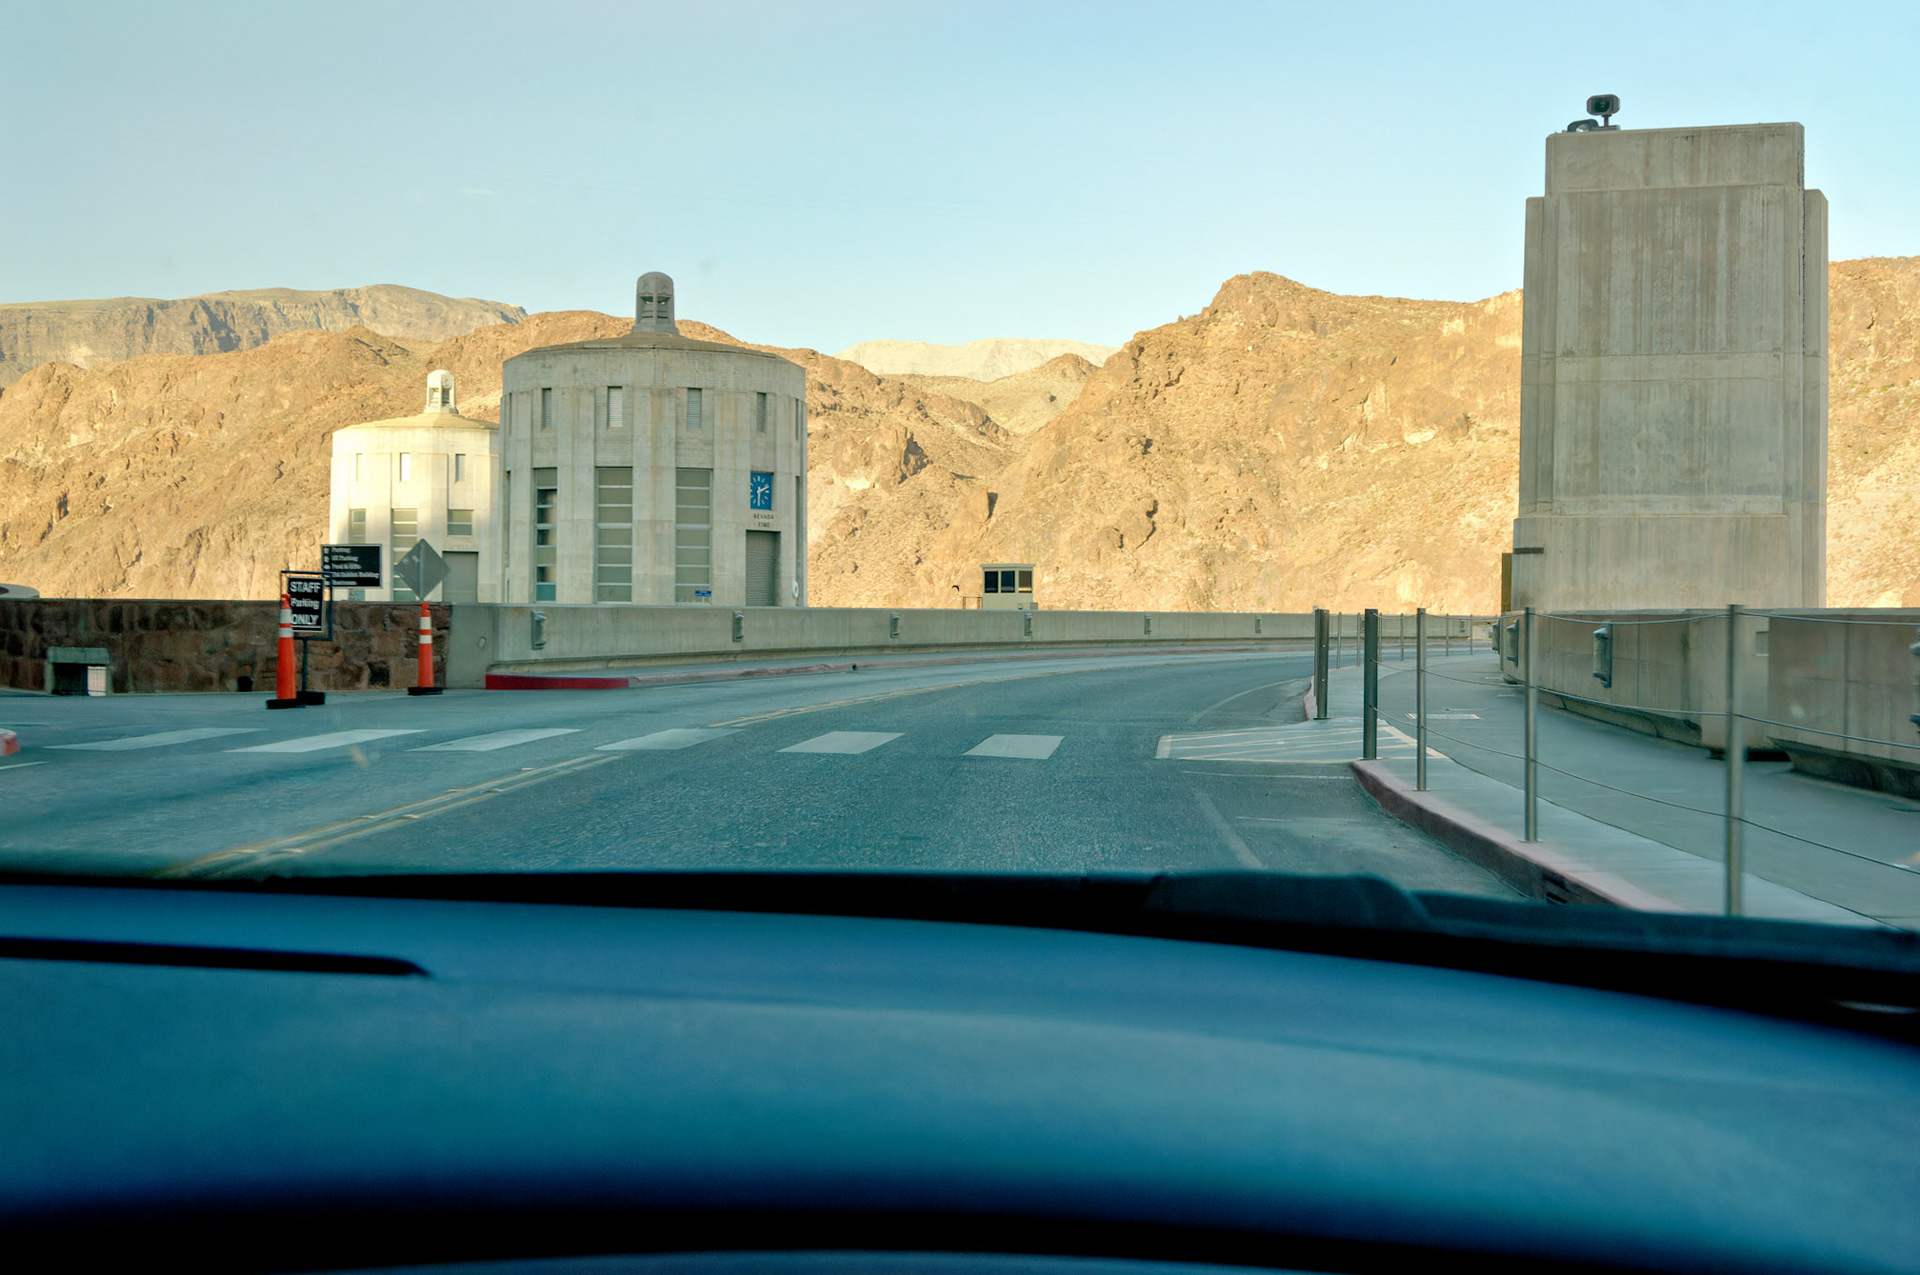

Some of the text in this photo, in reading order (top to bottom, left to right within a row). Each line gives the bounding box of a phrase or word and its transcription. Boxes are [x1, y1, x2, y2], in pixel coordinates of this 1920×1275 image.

[290, 581, 321, 593] STAFF
[290, 597, 320, 610] Parking
[291, 613, 319, 625] ONLY
